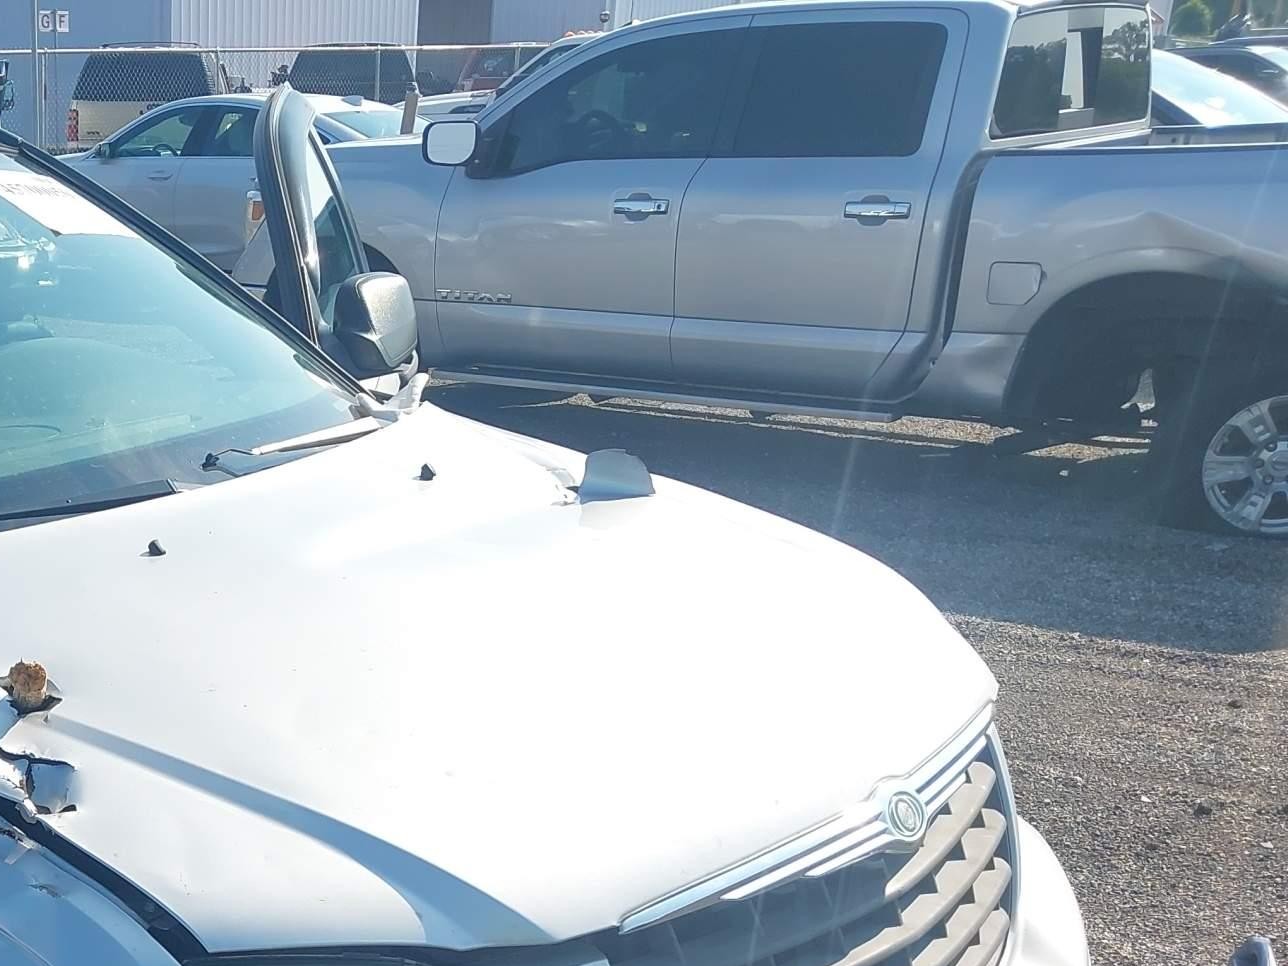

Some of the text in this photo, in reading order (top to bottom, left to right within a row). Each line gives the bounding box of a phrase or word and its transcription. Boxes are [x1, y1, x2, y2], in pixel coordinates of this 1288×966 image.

[41, 14, 51, 29] G
[58, 15, 66, 29] F
[435, 289, 512, 303] TITAN
